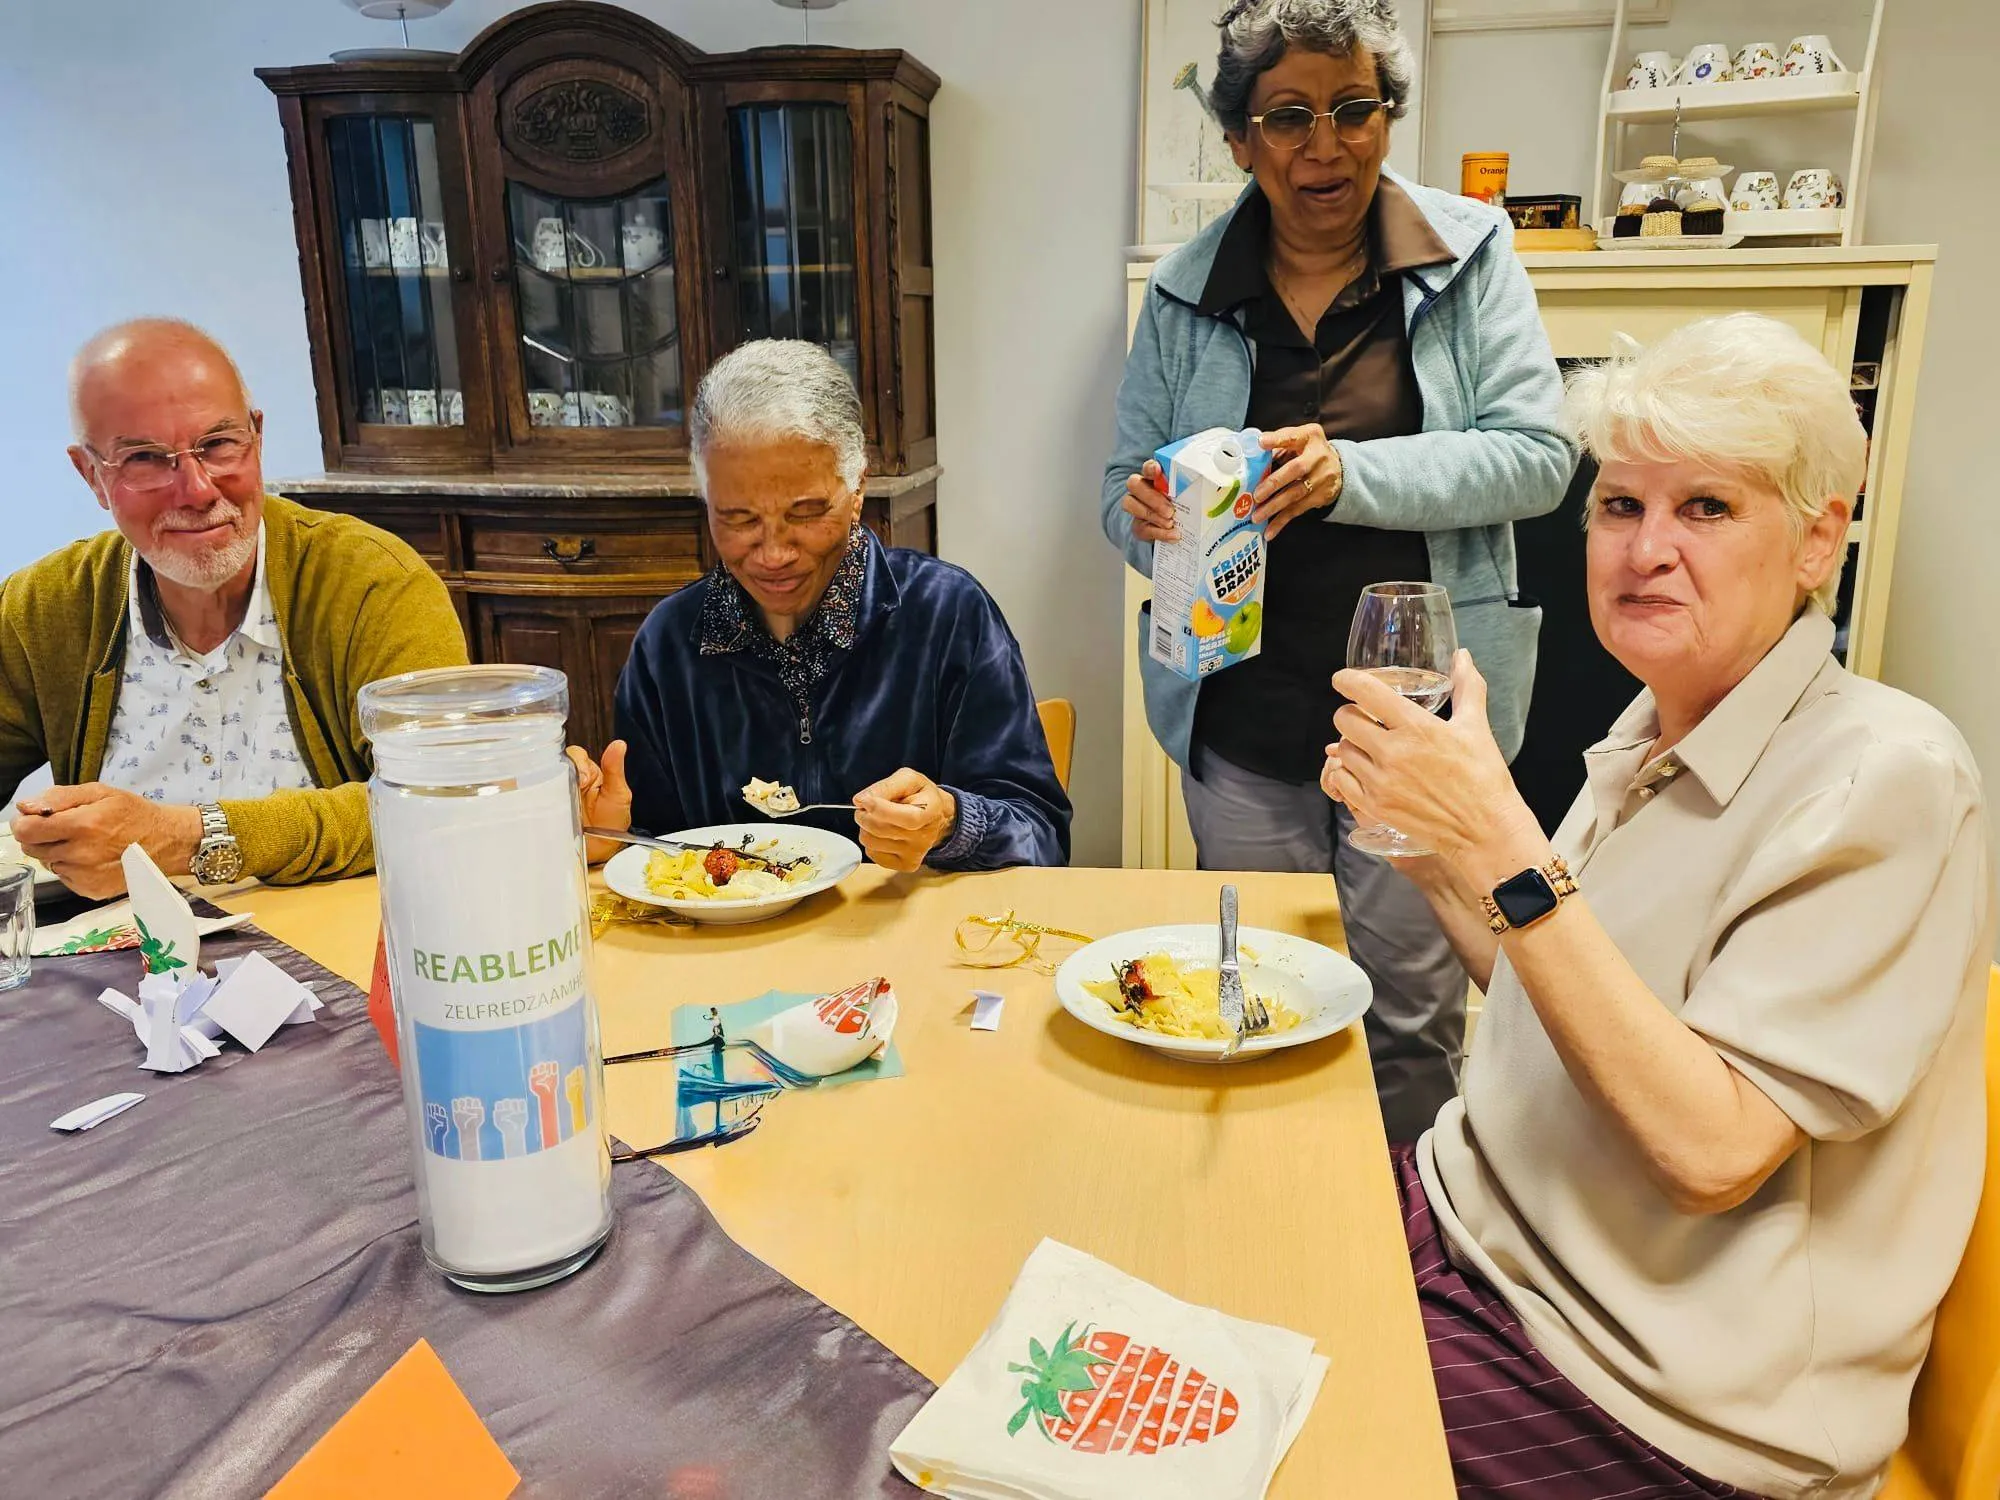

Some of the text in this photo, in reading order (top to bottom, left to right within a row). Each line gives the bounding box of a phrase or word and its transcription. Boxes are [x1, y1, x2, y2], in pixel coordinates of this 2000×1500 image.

[1479, 167, 1505, 176] Oranje
[1211, 534, 1259, 578] FRISSE
[1214, 547, 1259, 588] FRUIT
[1216, 558, 1261, 599] DRANK
